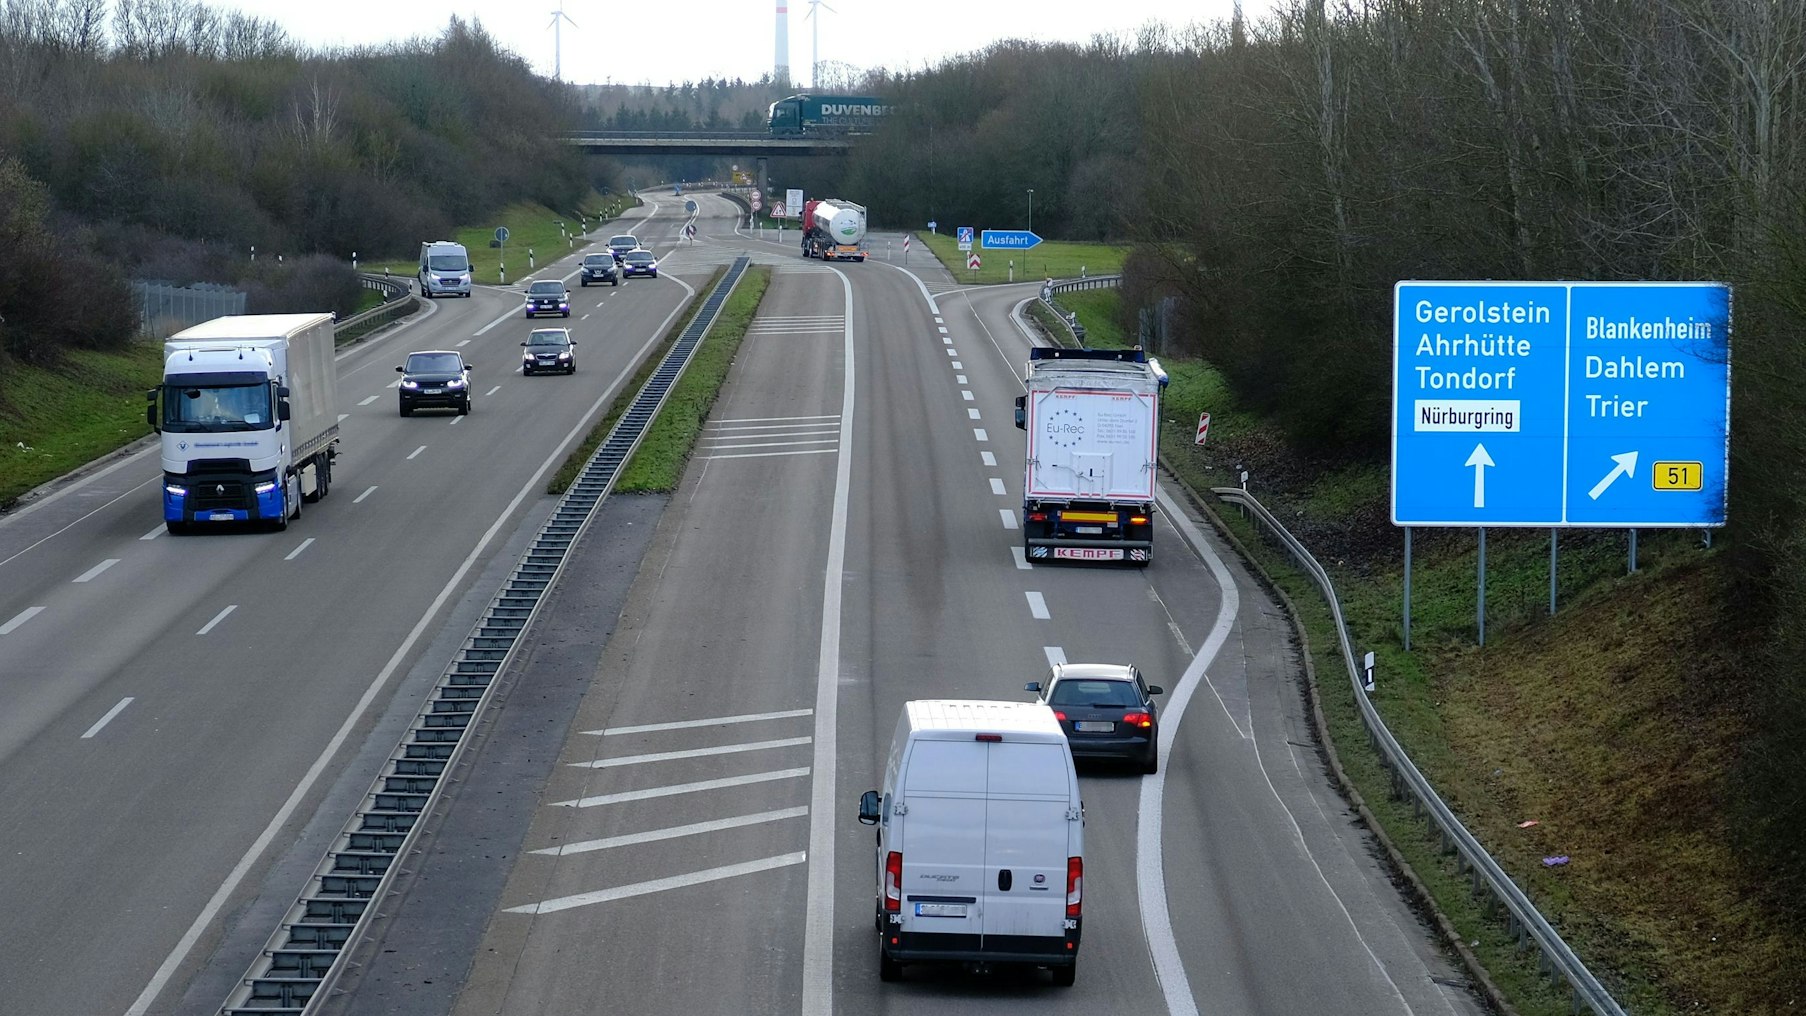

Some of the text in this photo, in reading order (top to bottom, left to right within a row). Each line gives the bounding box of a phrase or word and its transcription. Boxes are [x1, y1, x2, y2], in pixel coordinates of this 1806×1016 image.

[987, 235, 1028, 245] Ausfahrt
[1415, 300, 1550, 324] Gerolstein
[1586, 316, 1712, 339] Blankenheim
[1415, 333, 1531, 357] Ahrhütte
[1415, 366, 1516, 390] Tondorf
[1585, 355, 1685, 379] Dahlem
[1585, 394, 1649, 418] Trier
[1046, 423, 1085, 434] Eu-Rec
[1421, 407, 1513, 430] Nürburgring
[1668, 467, 1687, 485] 51
[1057, 549, 1121, 558] KEMPF
